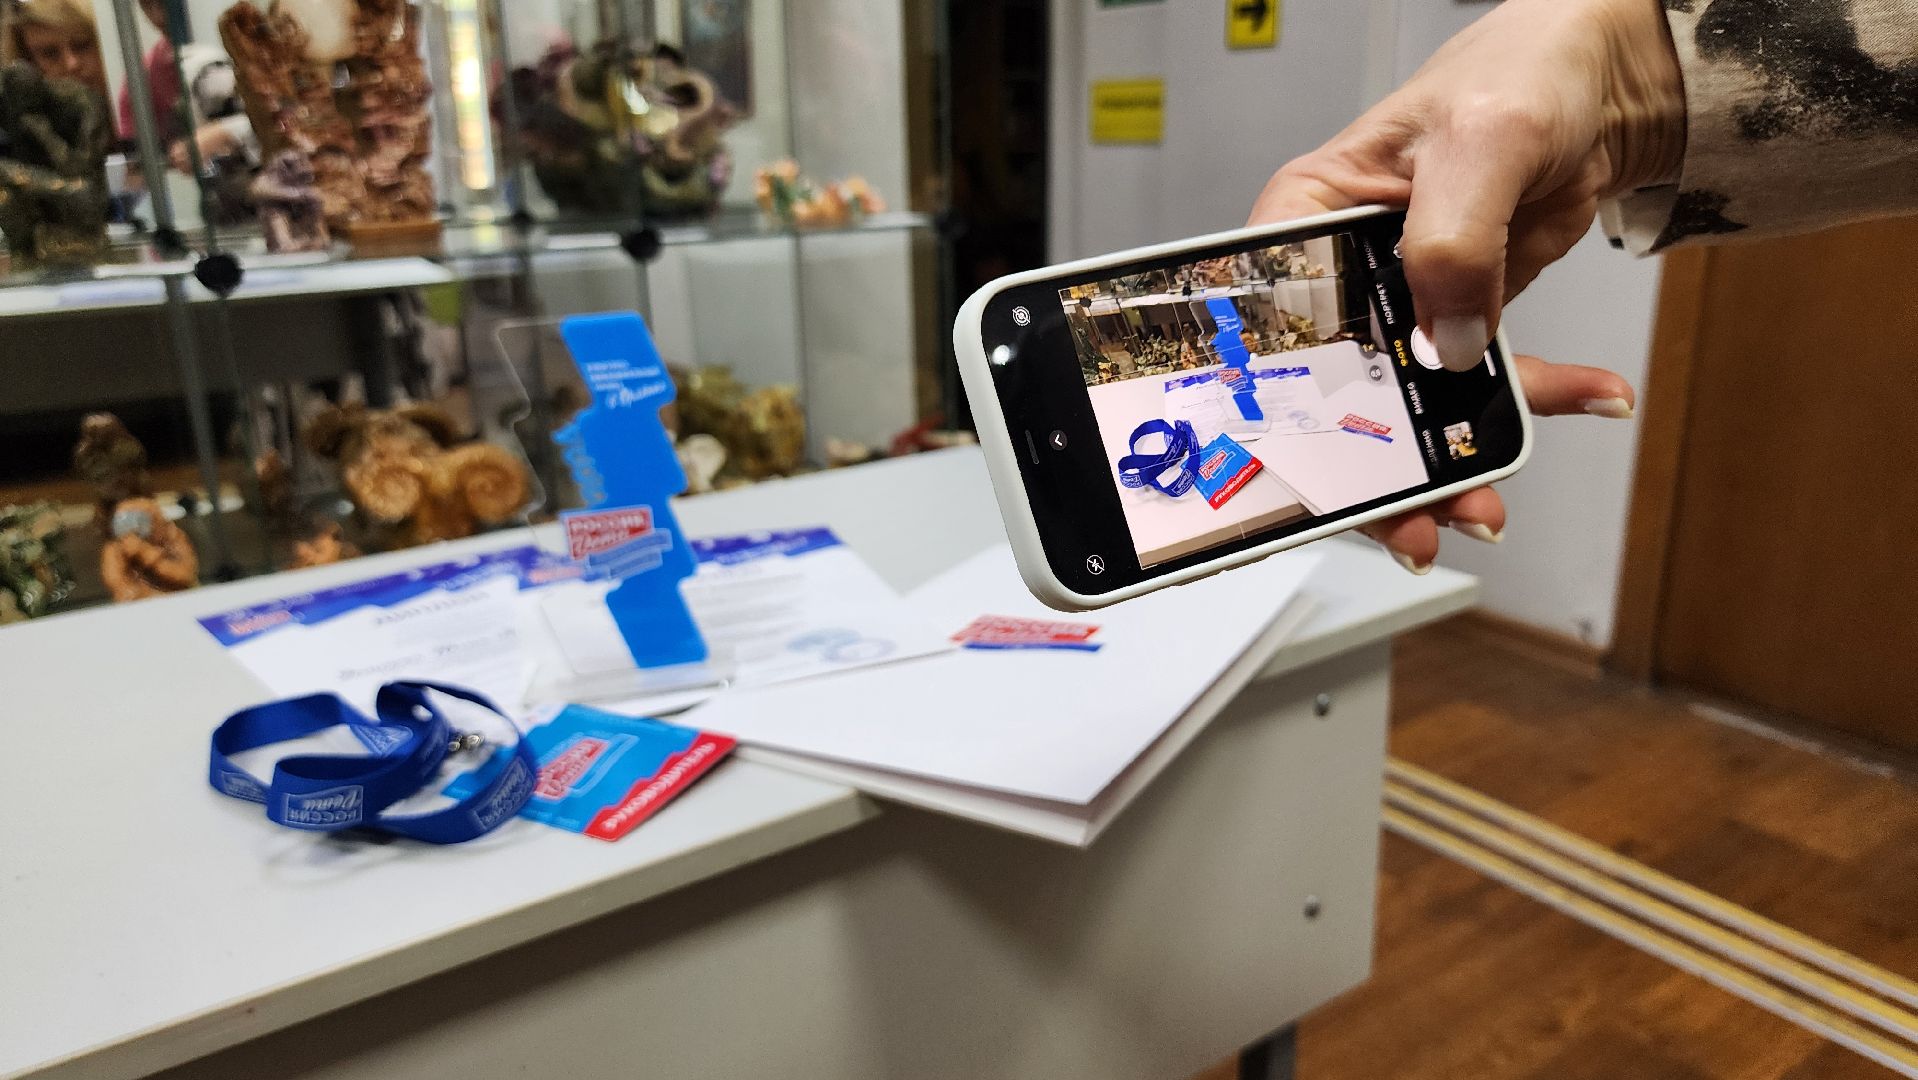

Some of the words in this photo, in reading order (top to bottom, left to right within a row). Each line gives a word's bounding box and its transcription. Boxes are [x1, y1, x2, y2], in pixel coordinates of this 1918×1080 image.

[1376, 282, 1394, 325] ПОРТРЕТ
[1394, 339, 1408, 366] ФОТО
[1407, 381, 1424, 415] ВИДЕО
[288, 807, 357, 824] РОССИЯ
